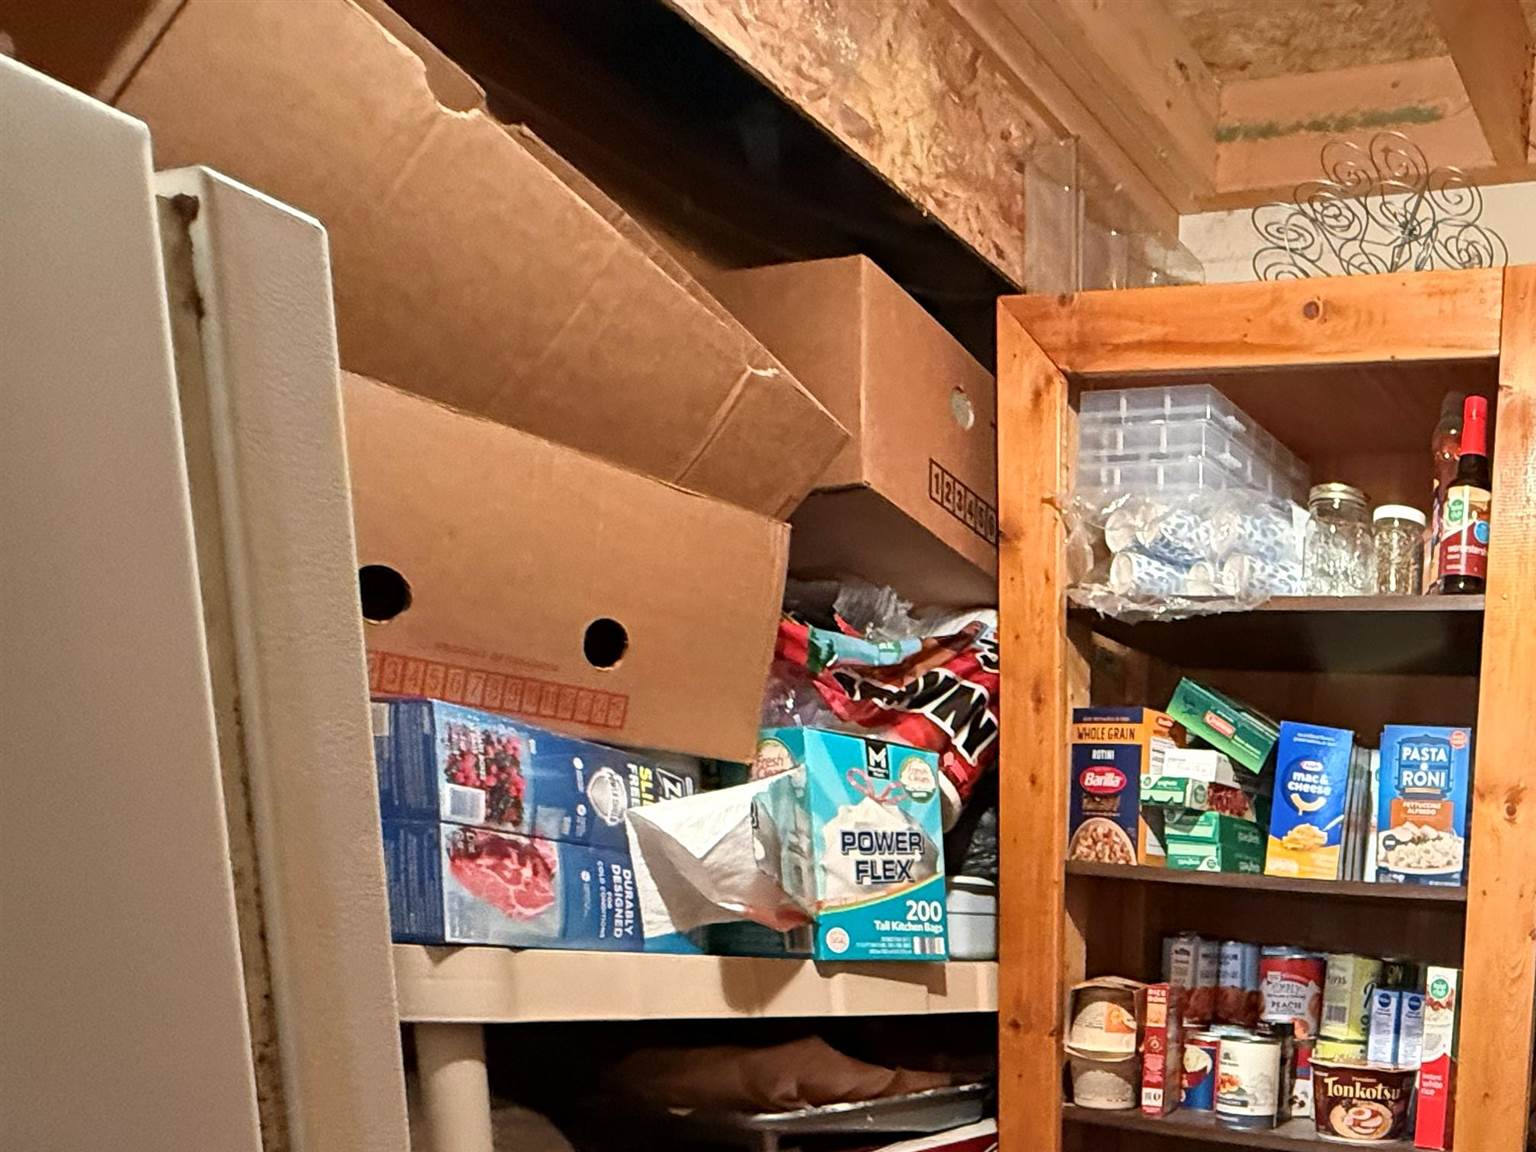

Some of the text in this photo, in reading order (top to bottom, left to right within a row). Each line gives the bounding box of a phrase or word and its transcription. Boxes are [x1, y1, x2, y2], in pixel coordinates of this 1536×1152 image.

[934, 472, 939, 495] 1
[945, 481, 951, 503] 2
[956, 490, 962, 512] 3
[1077, 727, 1135, 740] WHOLE GRAIN
[1401, 747, 1447, 762] PASTA
[627, 763, 640, 807] FREE
[638, 766, 655, 807] SLI
[840, 830, 925, 855] POWER
[855, 859, 916, 884] FLEX
[611, 864, 624, 938] DESIGNED
[622, 868, 635, 936] DURABLY
[905, 900, 943, 922] 200
[873, 920, 944, 934] Tall Kitchen Bags
[1323, 1077, 1400, 1100] Tonkotsu
